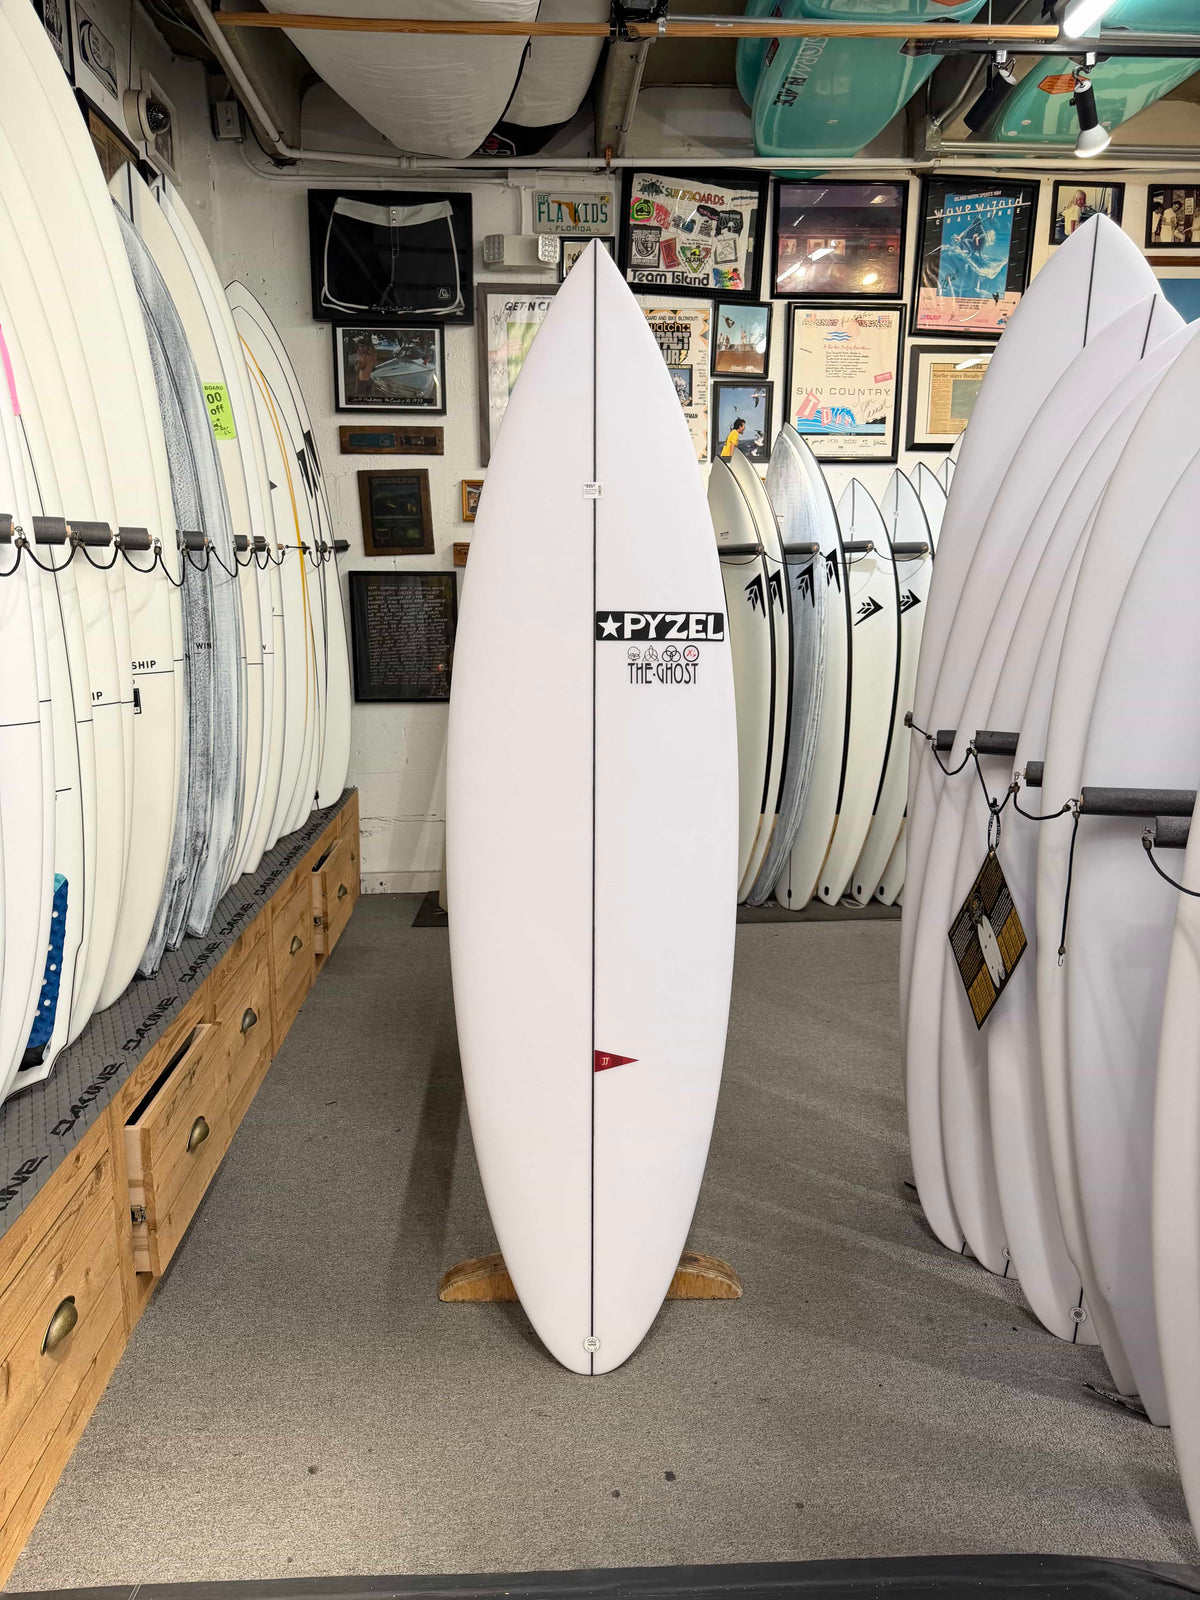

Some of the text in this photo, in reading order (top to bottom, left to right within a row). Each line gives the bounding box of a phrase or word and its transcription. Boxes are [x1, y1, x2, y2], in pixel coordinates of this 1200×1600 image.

[538, 202, 608, 224] FLA KIDS
[632, 268, 711, 287] Team Island
[650, 321, 682, 332] watch
[654, 332, 691, 350] PACT
[796, 387, 891, 396] SUN COUNTRY
[210, 404, 225, 416] off
[623, 612, 724, 640] PYZEL
[131, 660, 157, 670] SHIP
[627, 662, 699, 684] THE GHOST
[122, 996, 179, 1052] DAKINE
[51, 1061, 125, 1137] DAKINE
